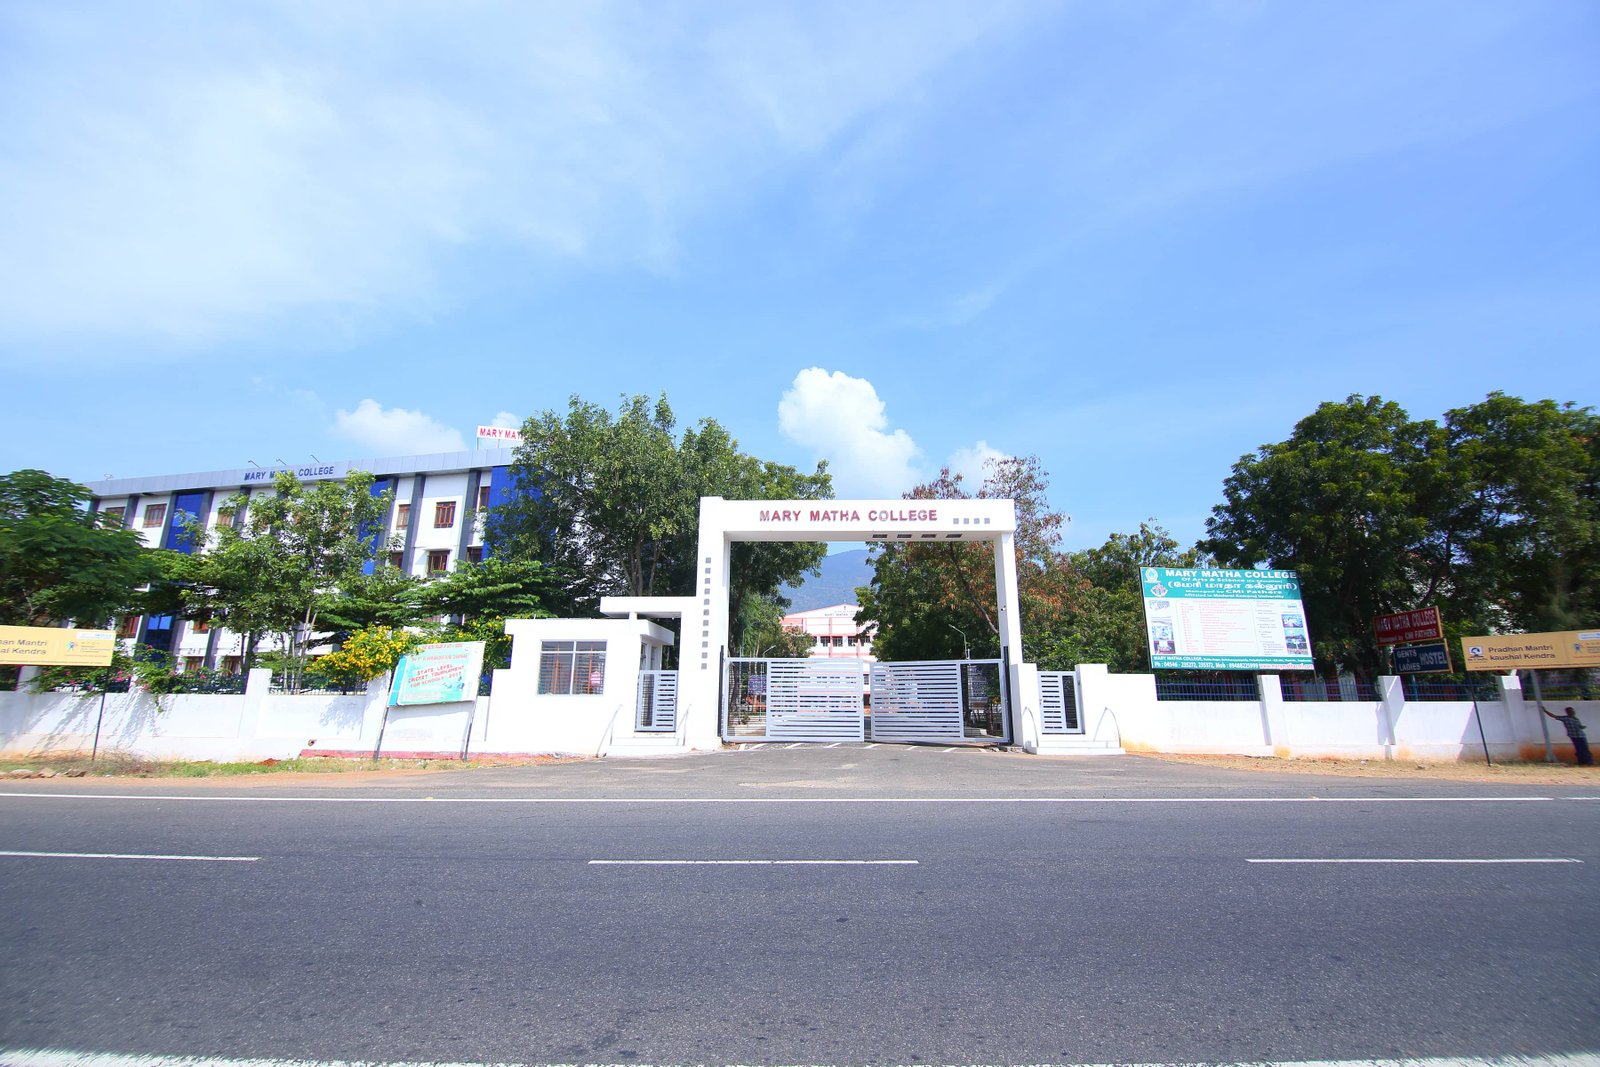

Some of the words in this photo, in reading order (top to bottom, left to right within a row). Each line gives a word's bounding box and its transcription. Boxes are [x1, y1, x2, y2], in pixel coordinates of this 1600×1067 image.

[480, 428, 503, 437] MARY
[244, 471, 266, 480] MARY
[299, 466, 334, 476] COLLEGE
[759, 509, 801, 522] MARY
[810, 510, 860, 522] MATHA
[868, 509, 938, 522] COLLEGE
[1202, 570, 1241, 578] MATHA
[1411, 610, 1437, 627] COLLEGE
[1396, 649, 1417, 658] GENTS
[1420, 651, 1447, 665] HOSTEL
[1400, 662, 1421, 671] LADIES
